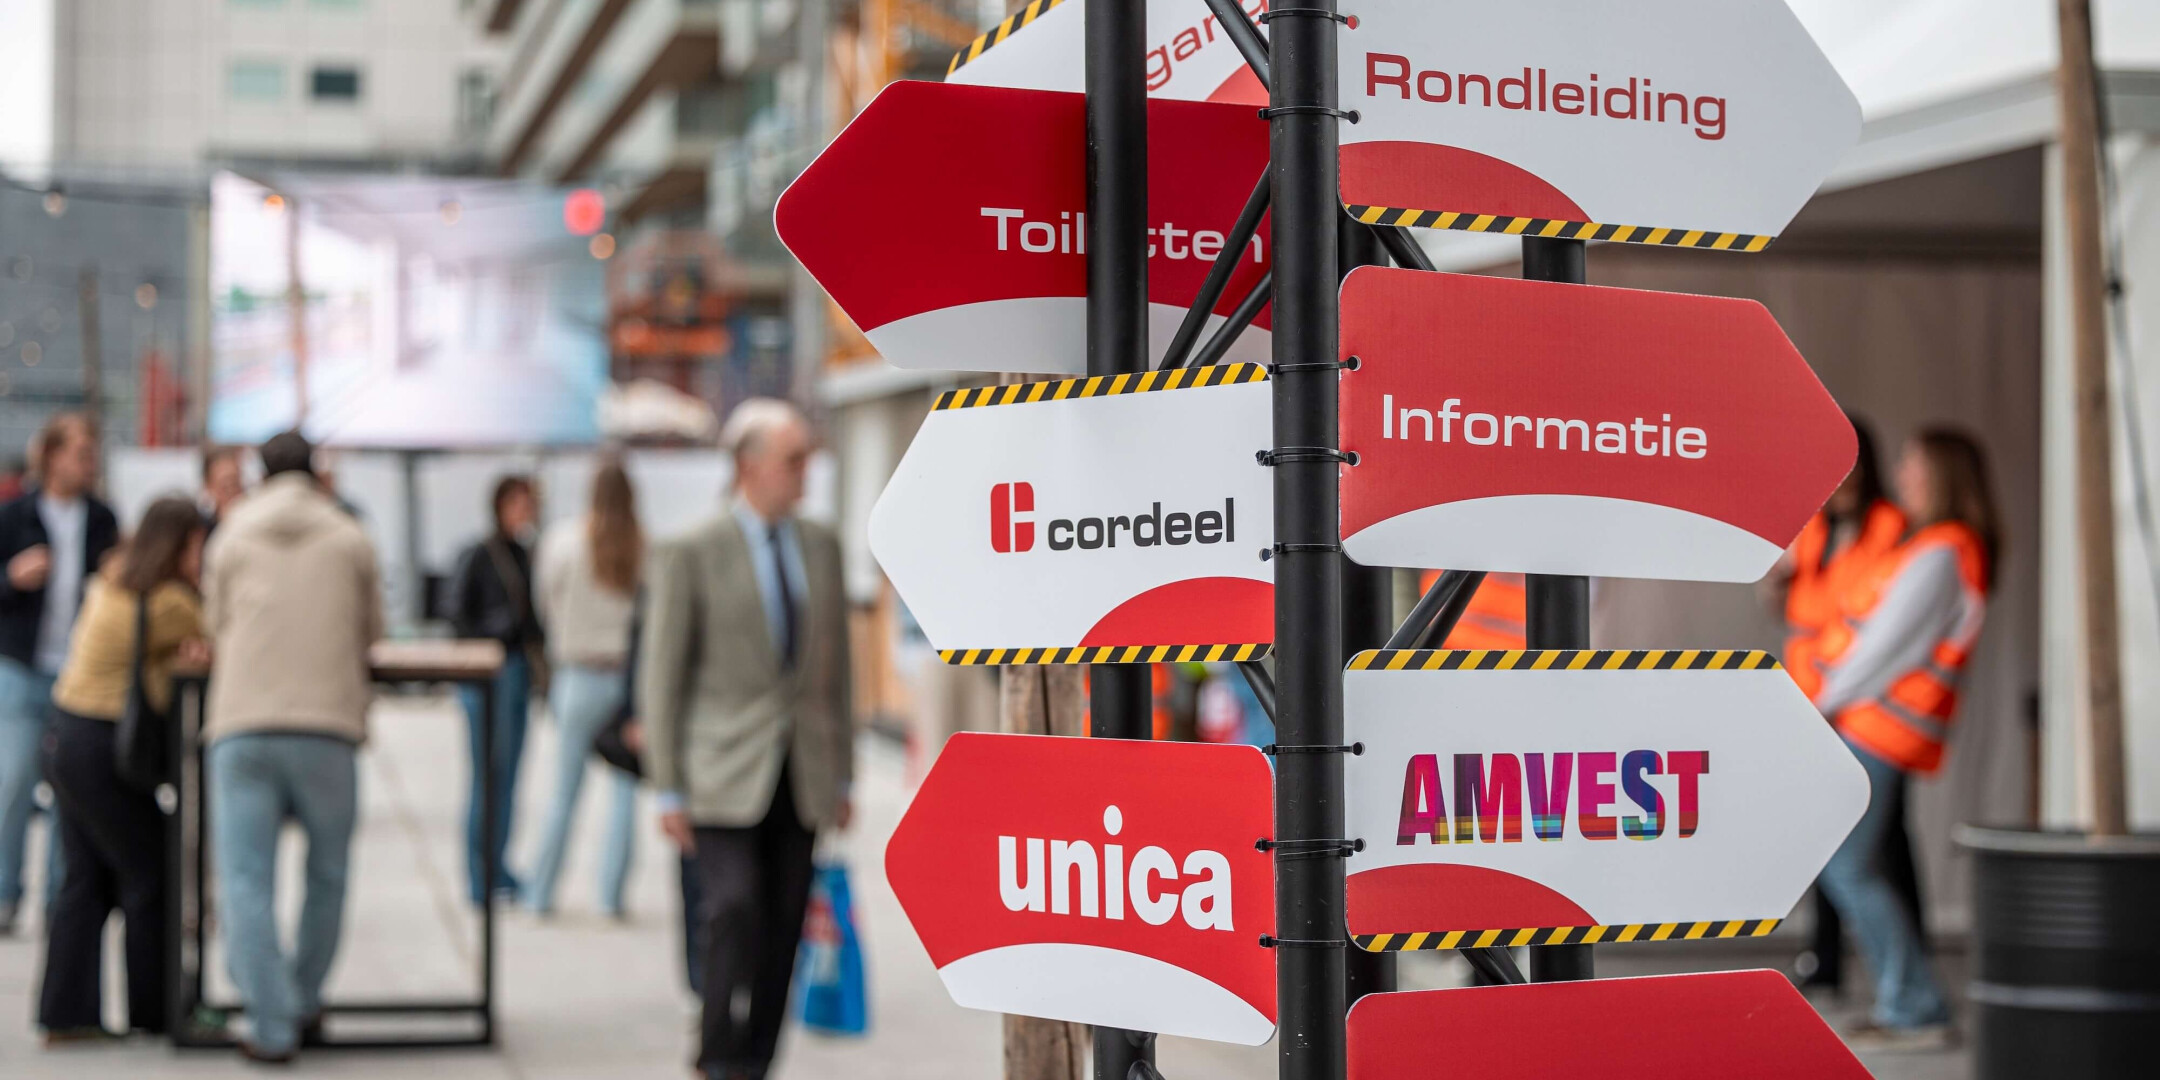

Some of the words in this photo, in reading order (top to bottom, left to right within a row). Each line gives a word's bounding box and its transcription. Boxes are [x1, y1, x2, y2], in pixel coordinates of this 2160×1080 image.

[1366, 52, 1726, 141] Rondleiding
[980, 207, 1263, 263] Toiltten
[1383, 394, 1708, 459] Informatie
[1048, 497, 1235, 551] cordeel
[1396, 749, 1710, 846] AMVEST
[998, 805, 1234, 932] unica
